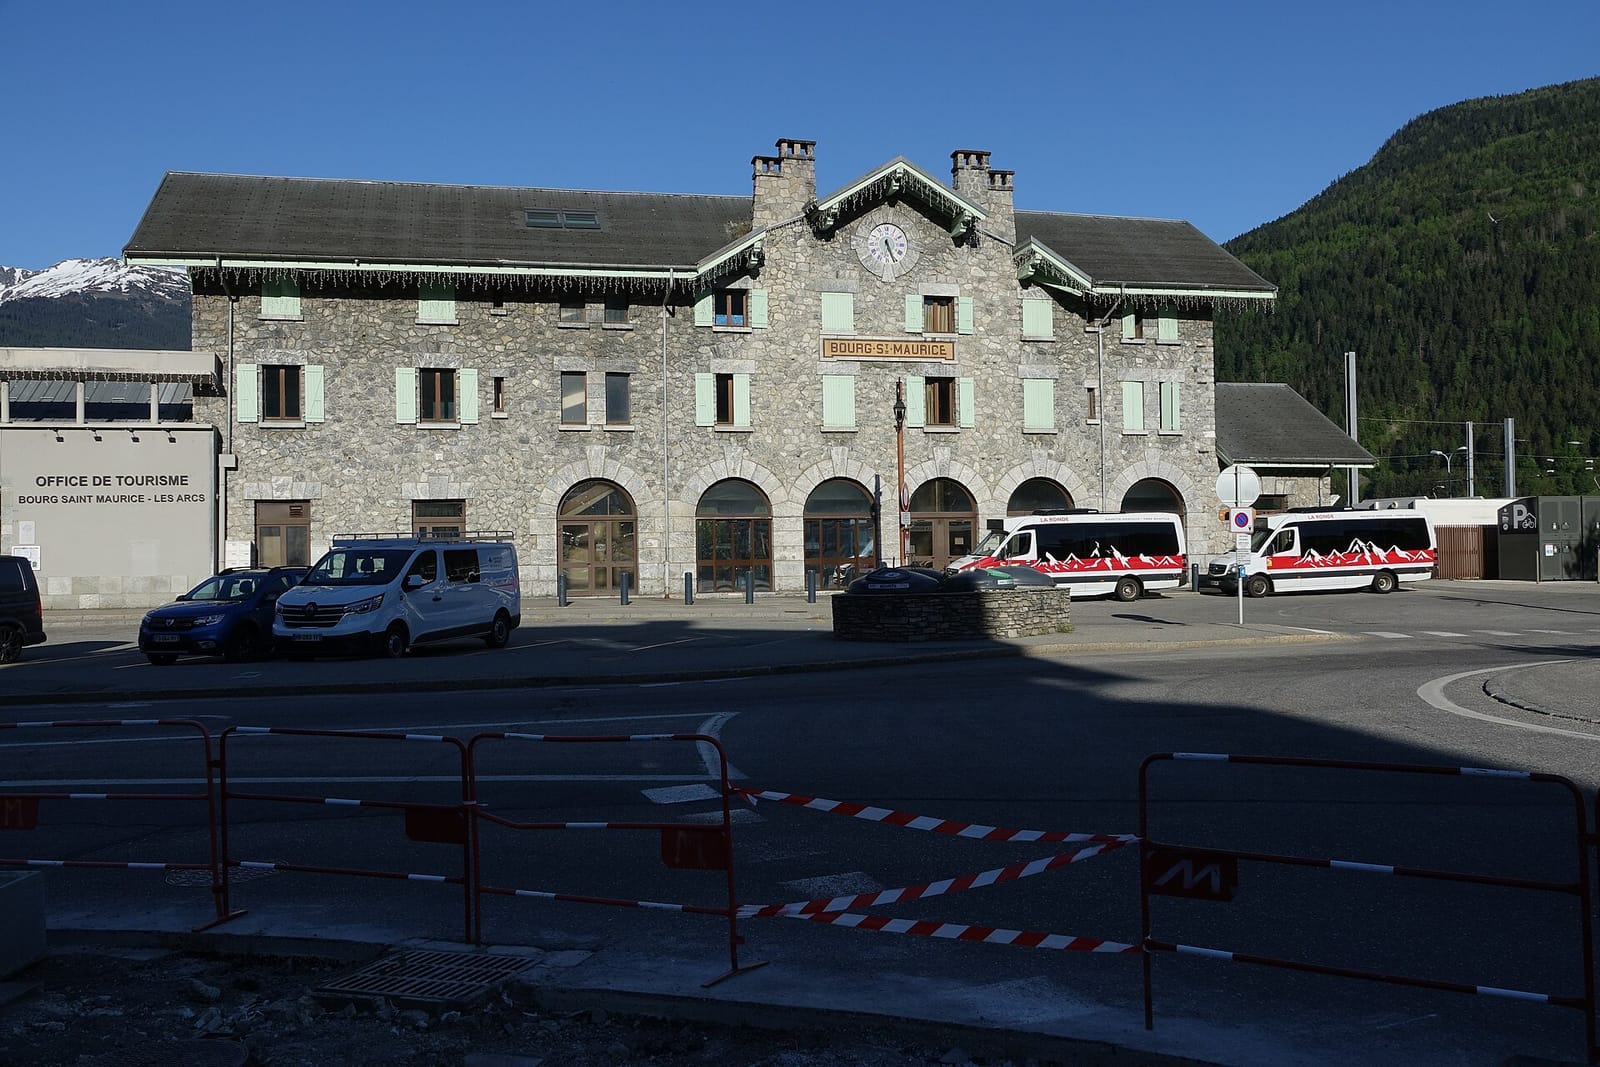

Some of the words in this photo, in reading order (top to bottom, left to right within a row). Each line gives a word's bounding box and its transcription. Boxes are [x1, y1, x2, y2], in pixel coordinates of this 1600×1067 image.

[36, 475, 88, 487] OFFICE
[92, 475, 112, 487] DE
[115, 474, 189, 486] TOURISME
[18, 495, 58, 505] BOURG
[61, 494, 93, 504] SAINT
[96, 494, 145, 503] MAURICE
[154, 494, 174, 503] LES
[176, 493, 206, 503] ARCS
[1513, 504, 1528, 529] P
